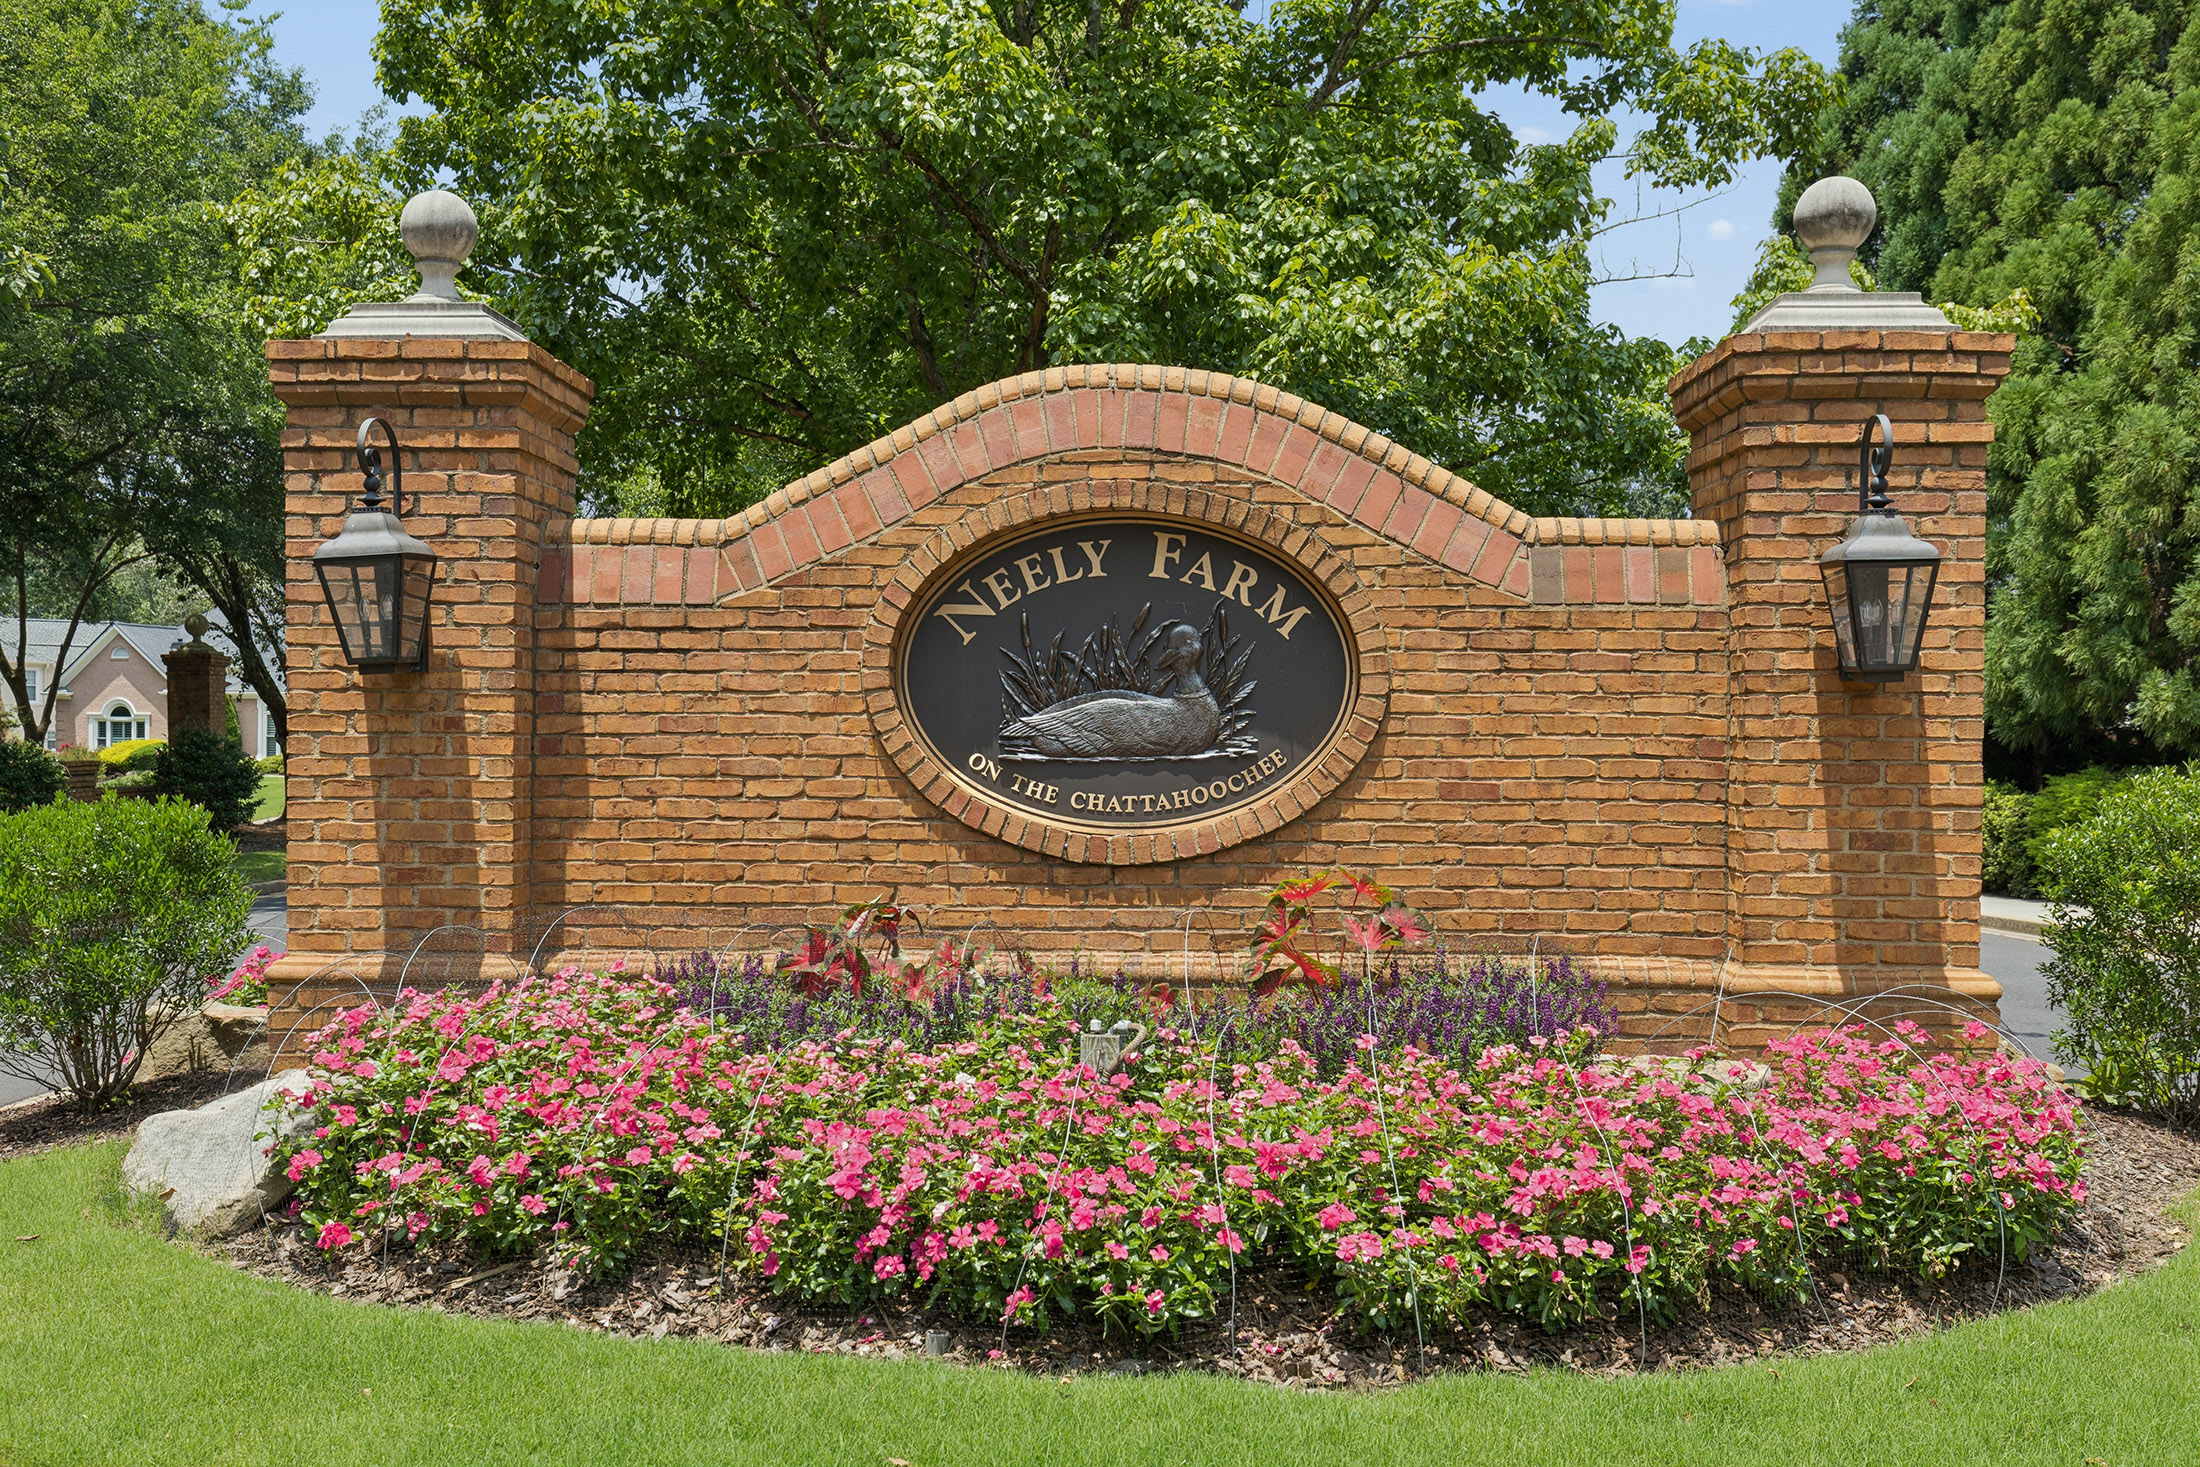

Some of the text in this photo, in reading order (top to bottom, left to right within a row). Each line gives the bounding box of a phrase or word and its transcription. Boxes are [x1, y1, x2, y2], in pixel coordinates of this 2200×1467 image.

[933, 531, 1311, 646] NEELY FARM
[968, 748, 1288, 814] ON THE CHATTAHOOCHEE
